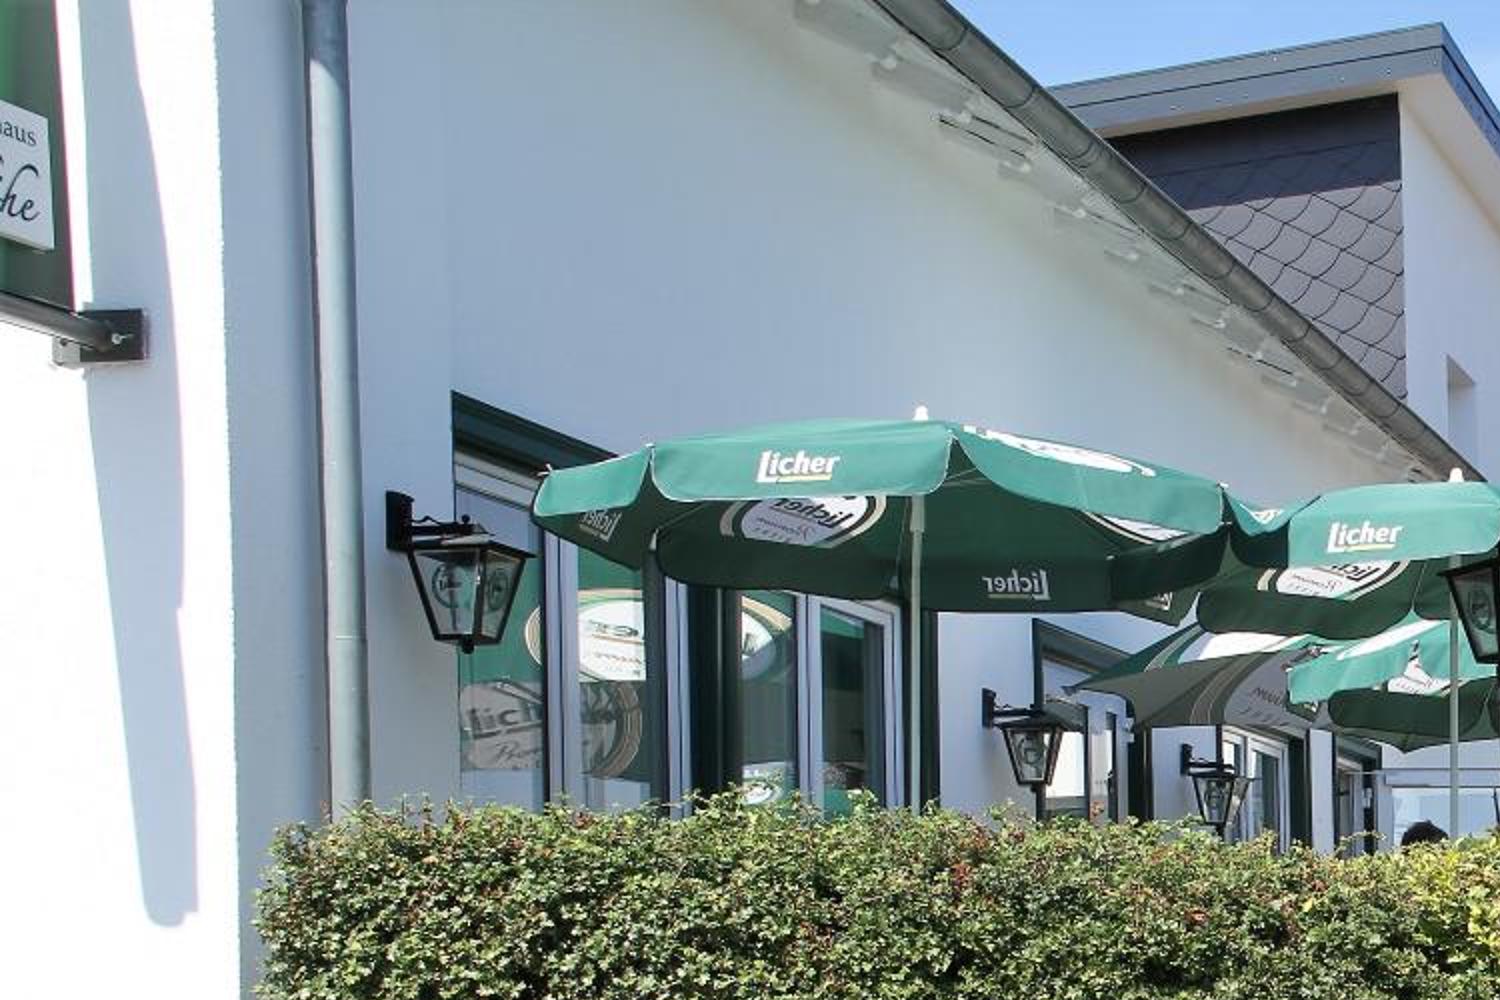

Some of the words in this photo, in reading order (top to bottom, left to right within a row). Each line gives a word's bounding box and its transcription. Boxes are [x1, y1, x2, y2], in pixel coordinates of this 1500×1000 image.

[0, 155, 40, 222] he
[756, 450, 840, 483] Licher
[1326, 521, 1403, 553] Licher
